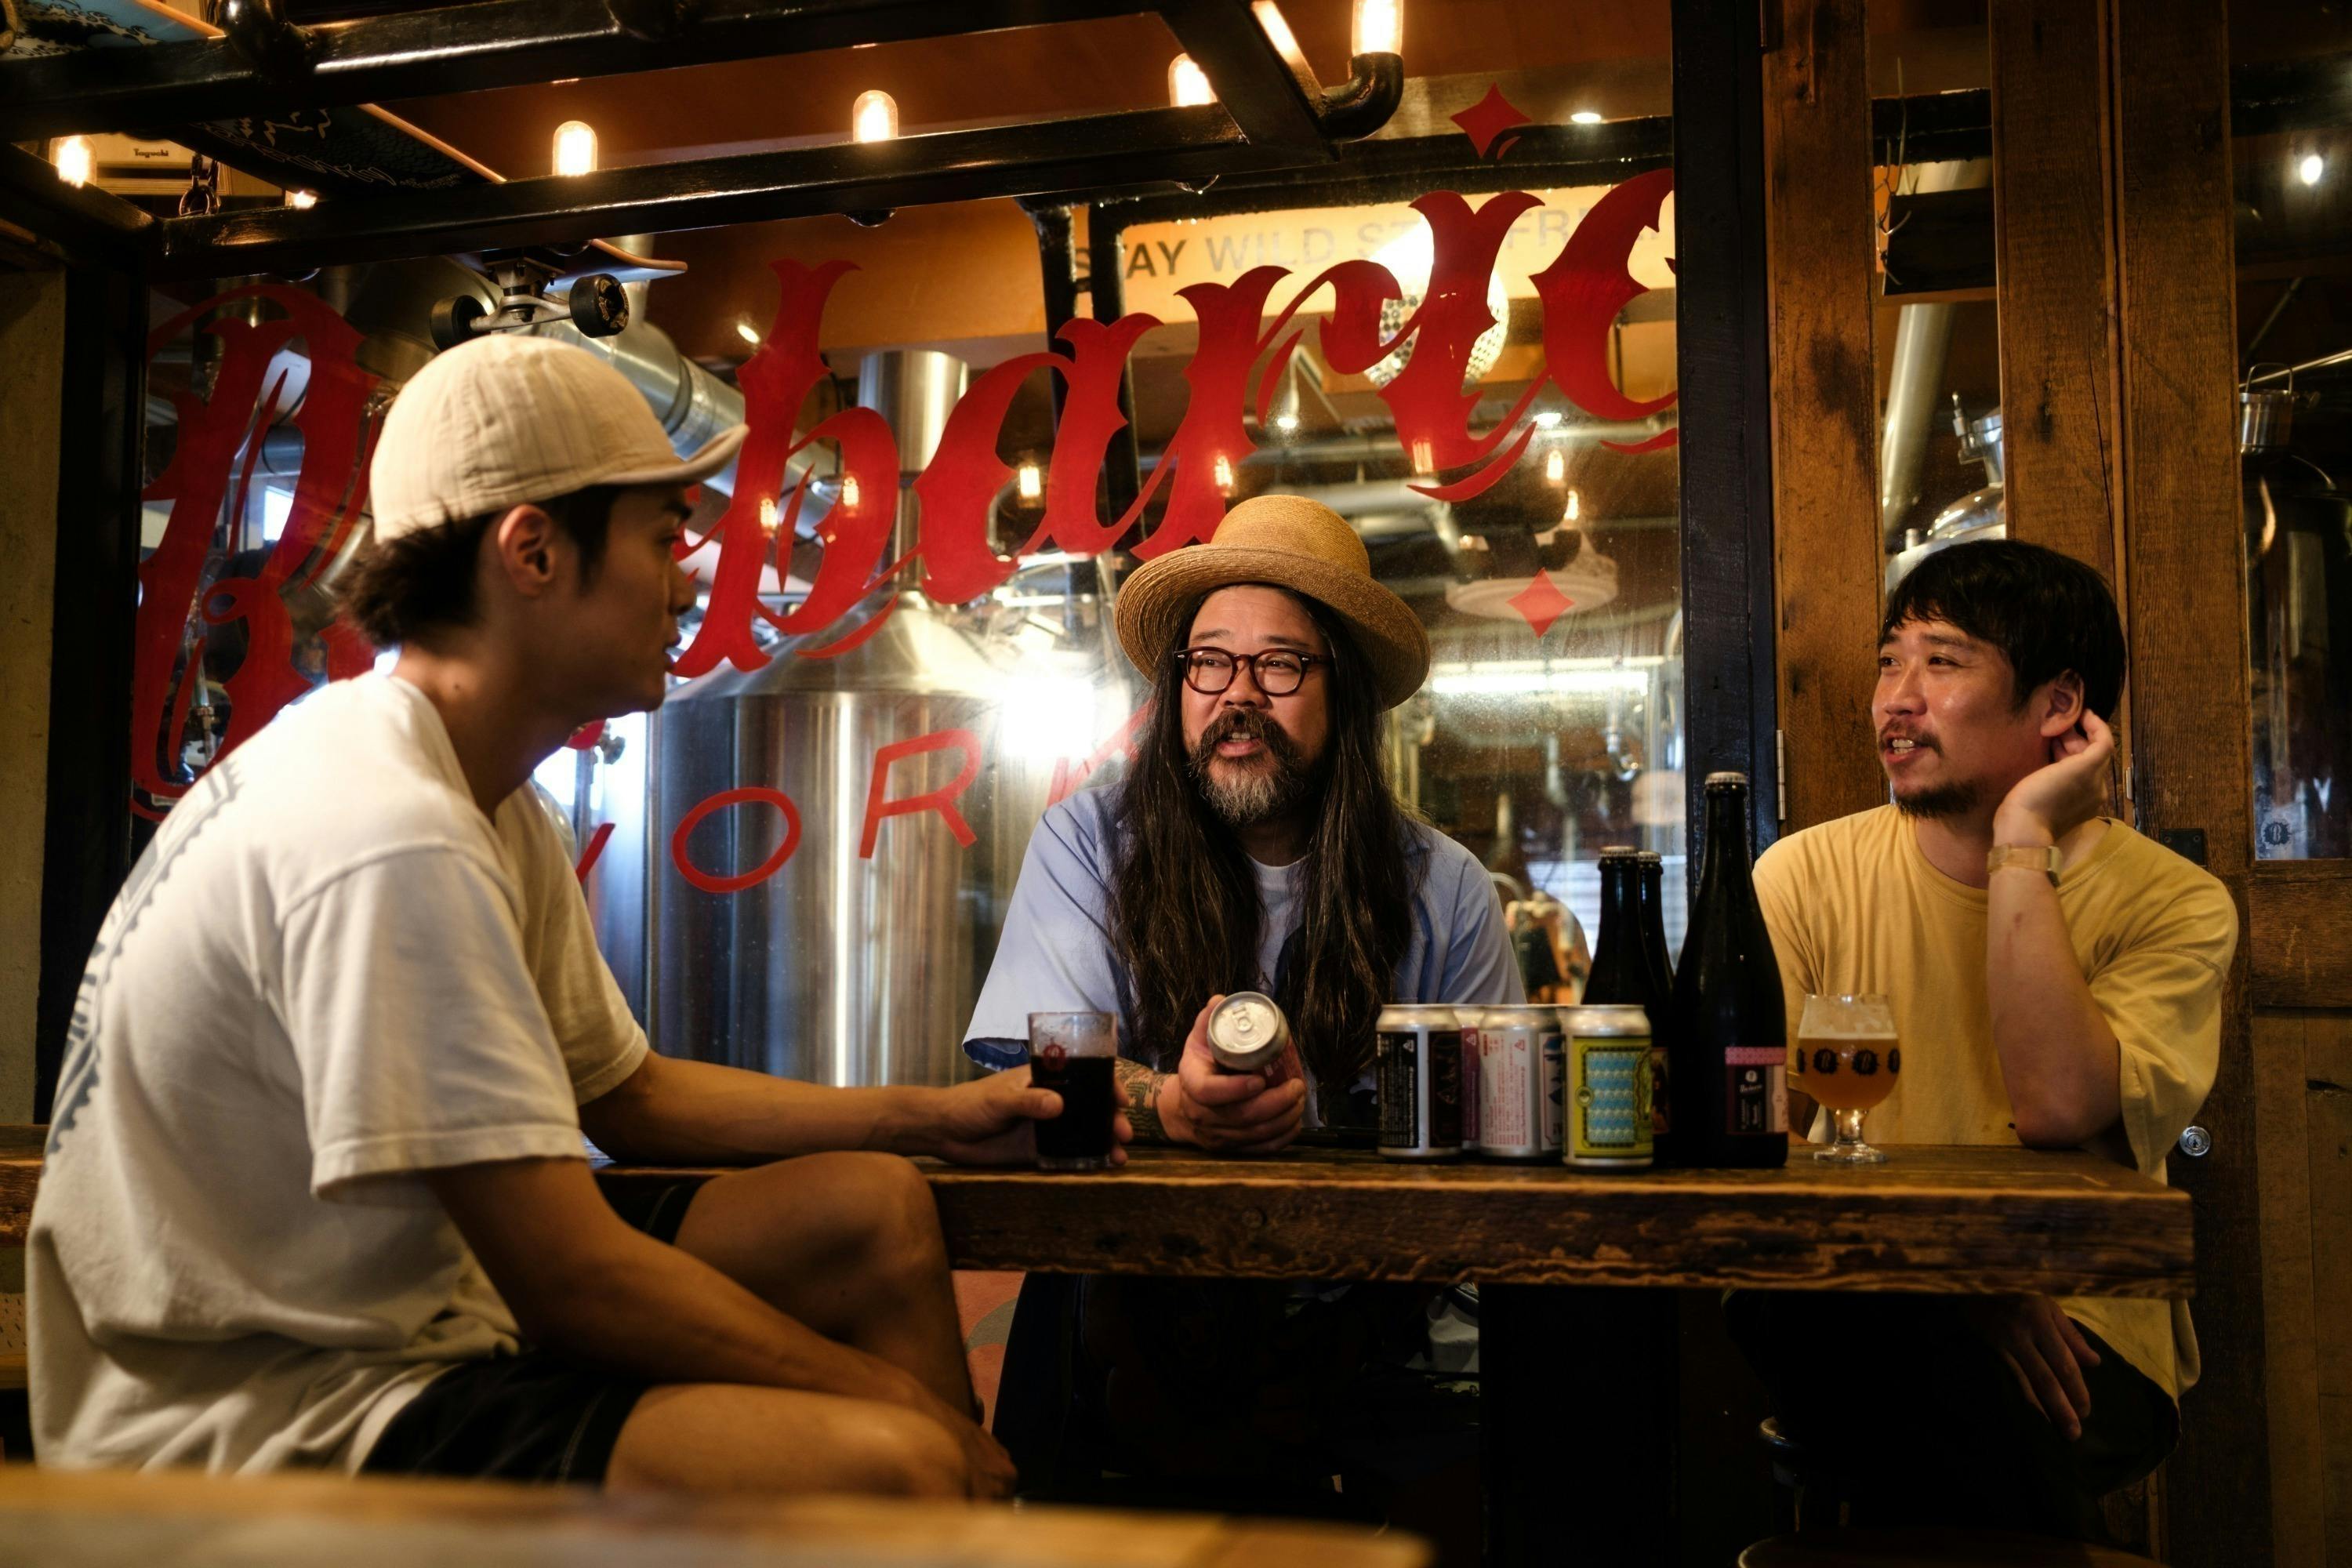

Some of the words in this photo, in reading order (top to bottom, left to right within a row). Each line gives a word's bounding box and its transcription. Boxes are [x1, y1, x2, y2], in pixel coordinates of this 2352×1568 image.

[133, 148, 169, 158] Taguchi
[1073, 238, 1187, 281] SAY
[1204, 227, 1334, 272] WILD
